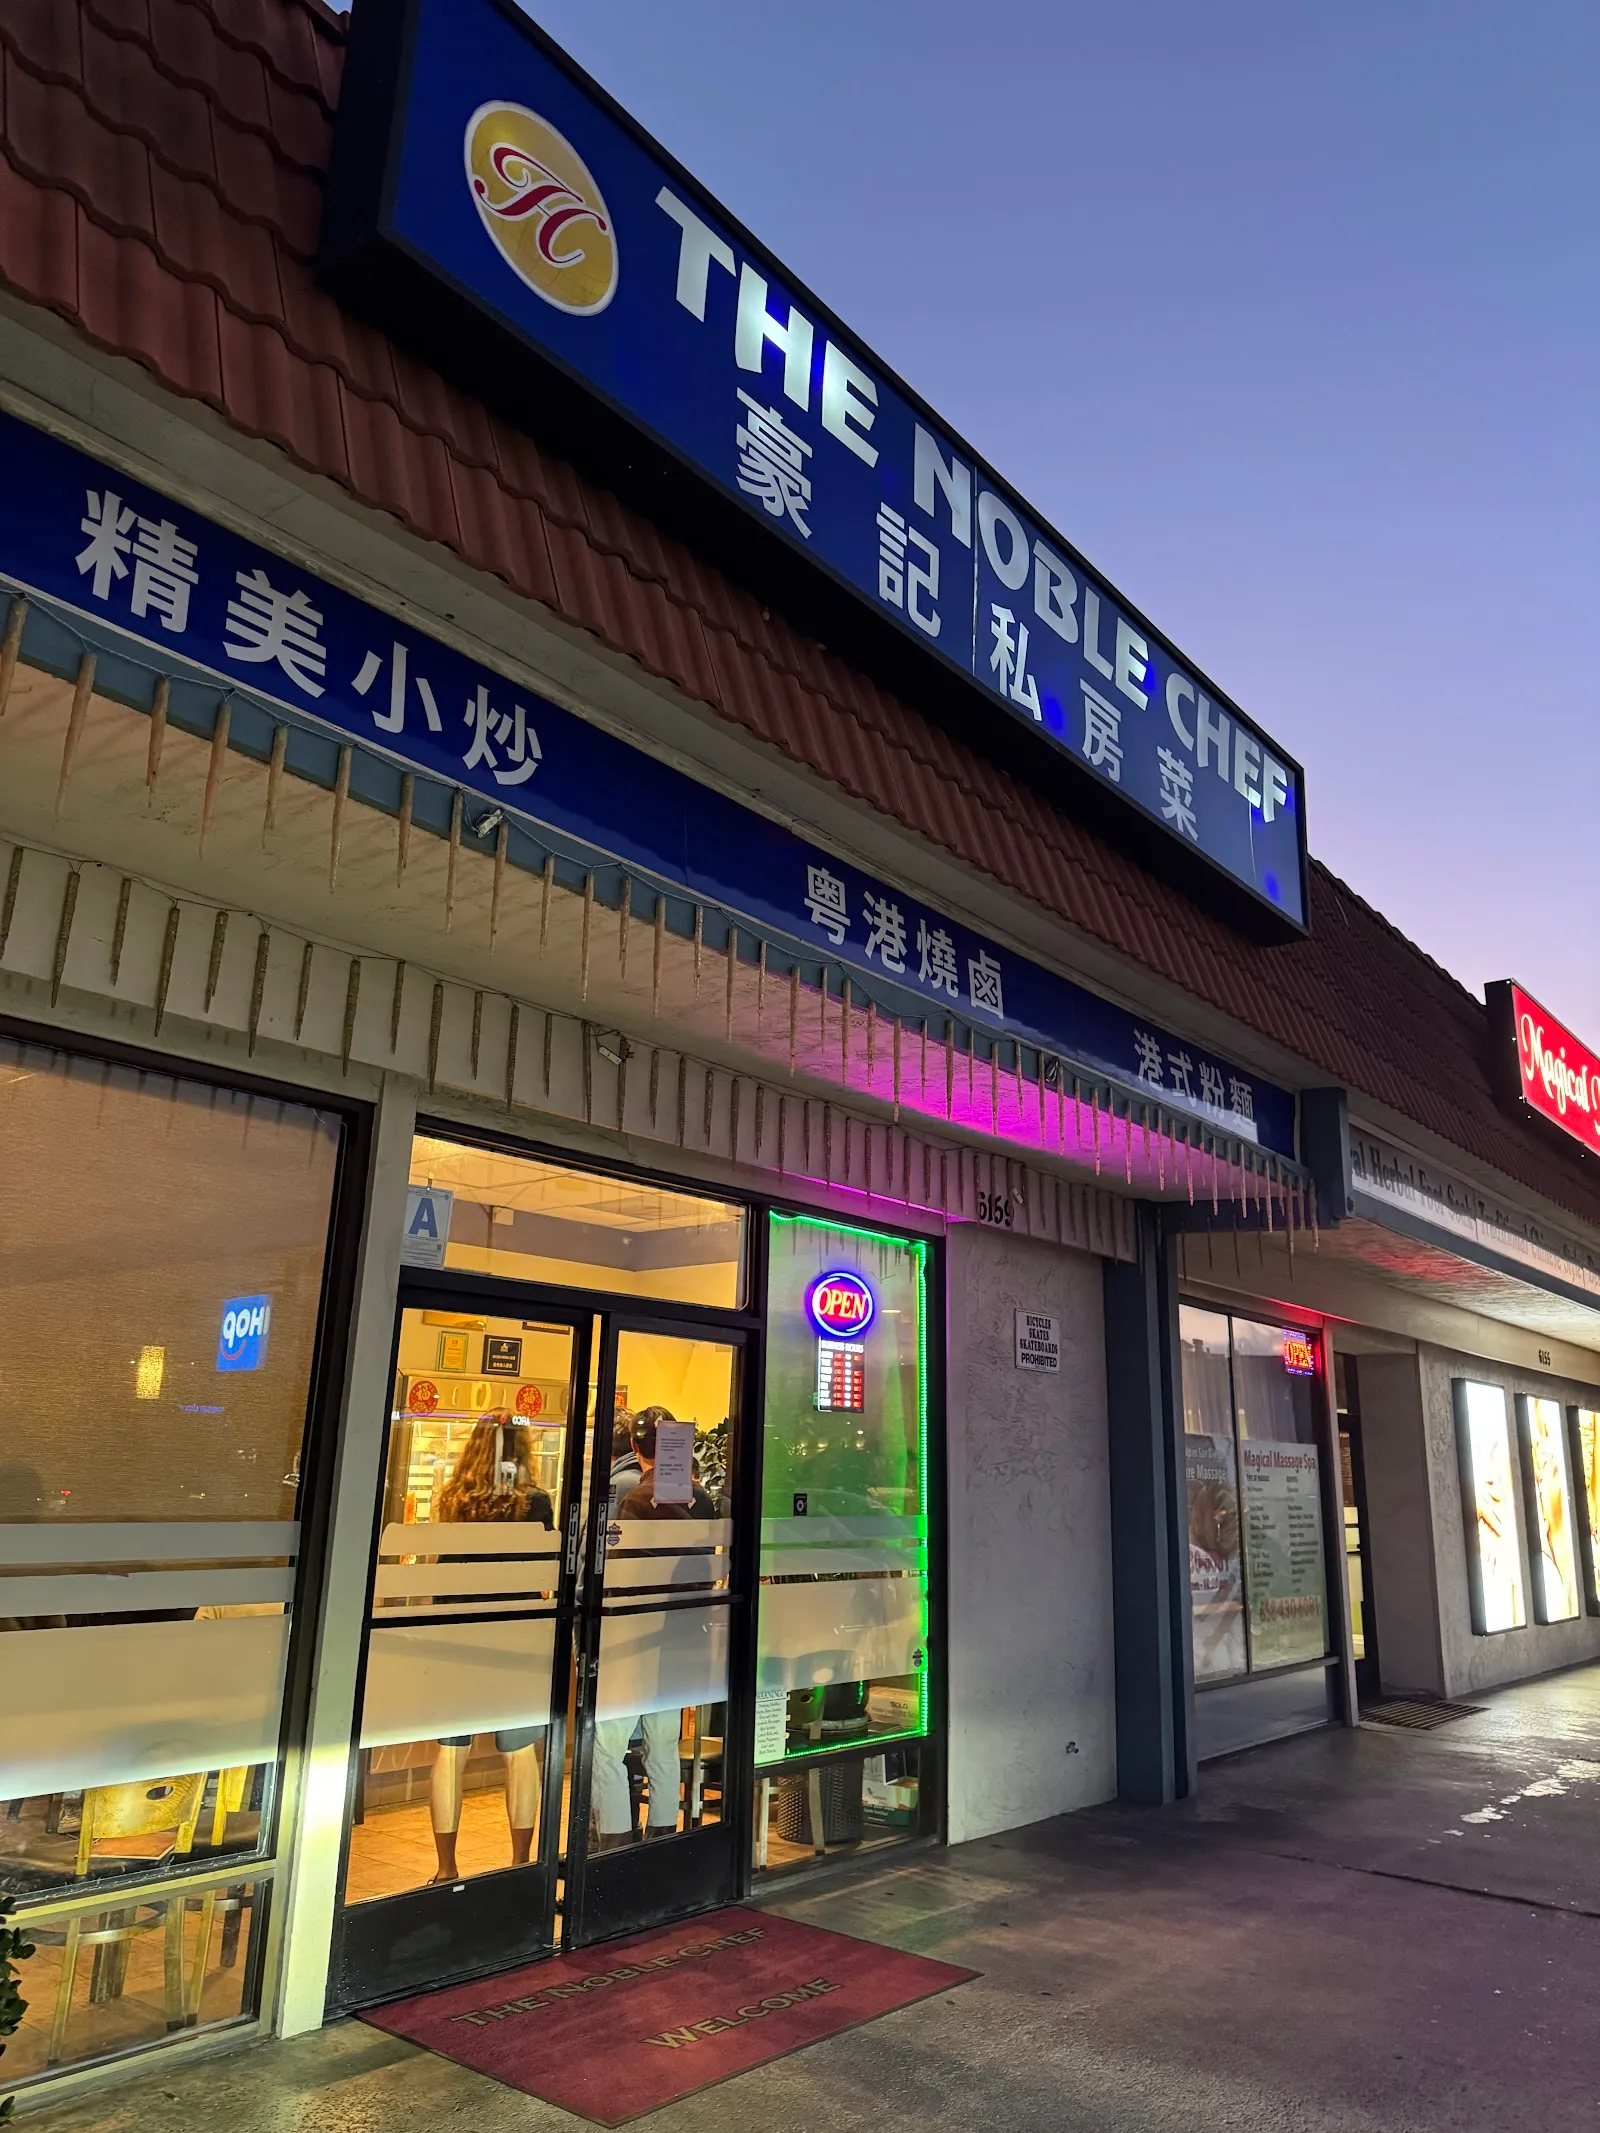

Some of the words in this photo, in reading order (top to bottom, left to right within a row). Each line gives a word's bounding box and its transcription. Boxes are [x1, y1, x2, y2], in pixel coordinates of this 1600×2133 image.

[655, 186, 879, 468] THE
[914, 423, 1149, 711] NOBLE
[1165, 672, 1288, 824] CHEF
[75, 489, 543, 786] 精美小炒
[736, 387, 1199, 841] 豪記私房菜
[1521, 1013, 1590, 1115] Magical
[1369, 1144, 1416, 1202] Herbal
[1418, 1168, 1445, 1216] Foot
[408, 1197, 438, 1238] A
[817, 1286, 868, 1321] OPEN
[1026, 1315, 1051, 1330] BICYCLES
[1020, 1338, 1058, 1355] SKATEBOARDS
[1021, 1352, 1058, 1368] PROHIBITED
[1029, 1328, 1049, 1341] SKATES
[1285, 1341, 1312, 1368] OPEN
[1538, 1349, 1551, 1366] 6155
[1244, 1450, 1272, 1472] Magical
[1273, 1452, 1303, 1473] Massage
[1303, 1453, 1316, 1474] Spa
[569, 1504, 579, 1573] PULL
[595, 1504, 606, 1573] PULL
[449, 1995, 550, 2028] THE
[546, 1953, 681, 2000] NOBLE
[676, 1926, 768, 1960] CHEF
[640, 1977, 843, 2050] WELCOME
